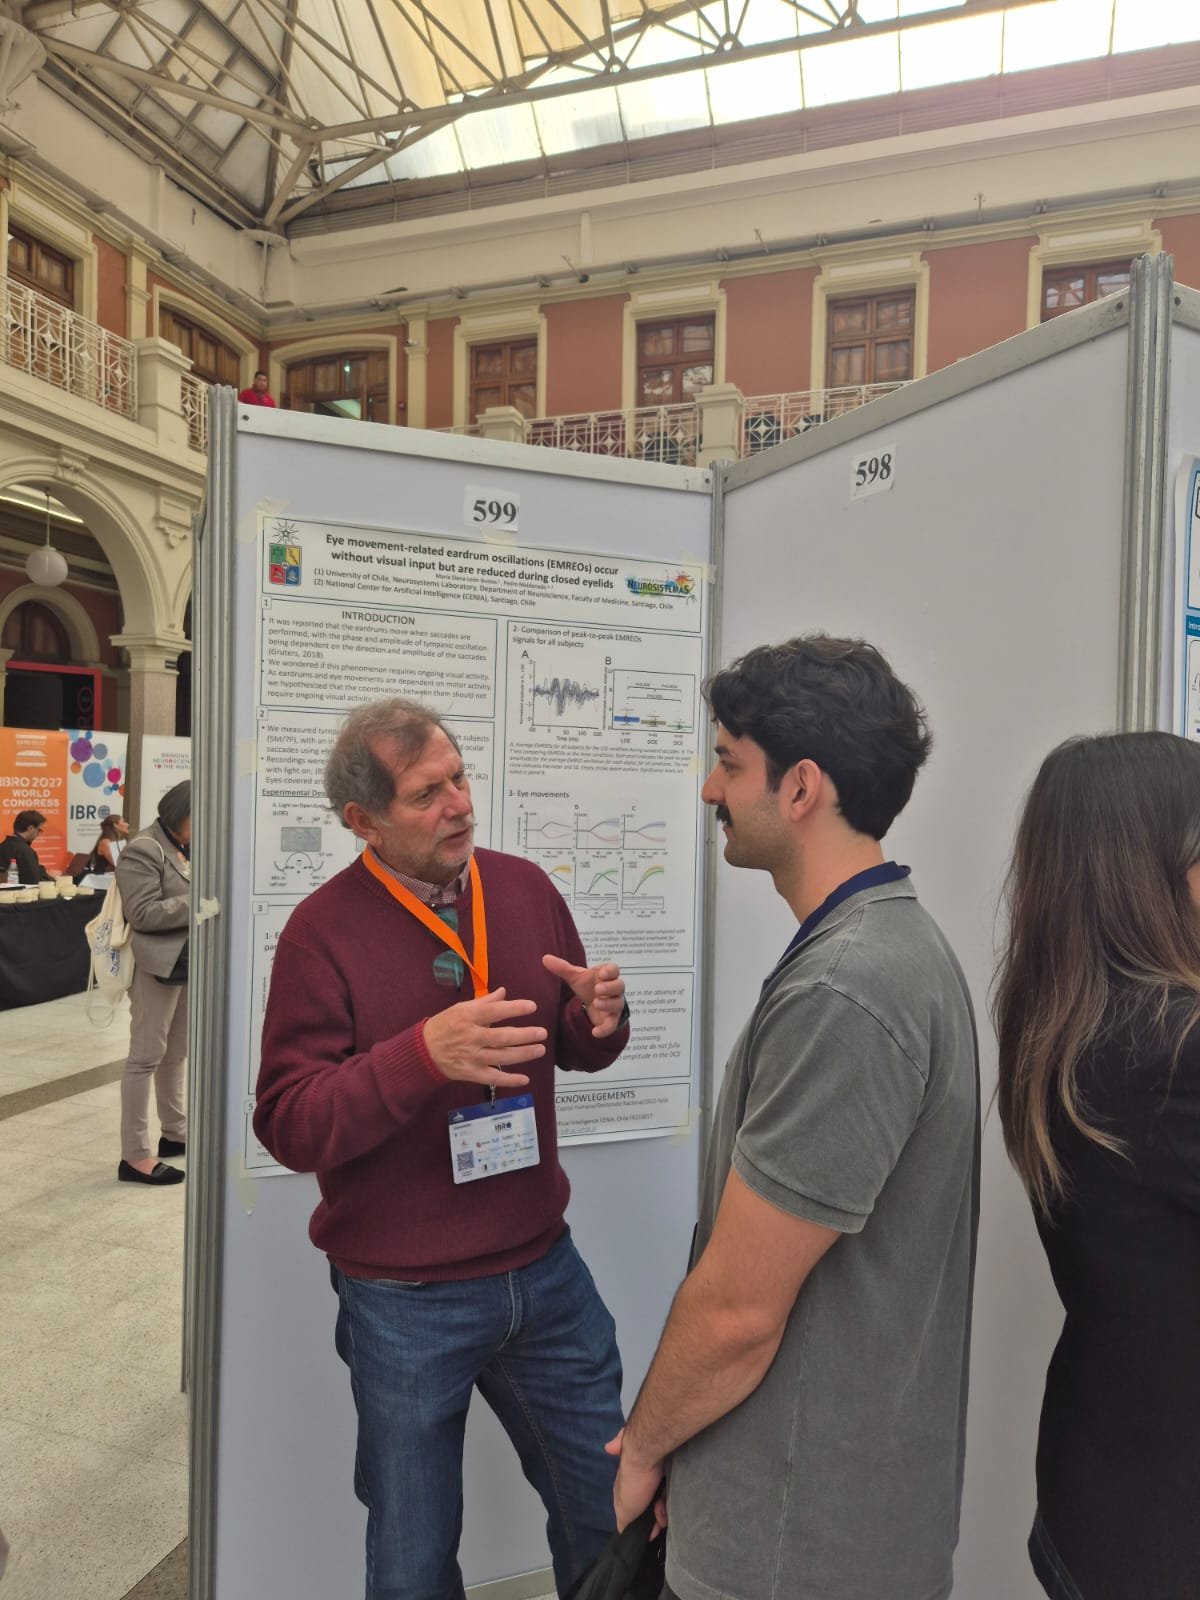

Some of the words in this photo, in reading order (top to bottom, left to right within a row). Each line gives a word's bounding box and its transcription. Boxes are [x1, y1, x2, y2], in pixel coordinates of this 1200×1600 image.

[856, 453, 892, 486] 598
[474, 500, 516, 524] 599
[326, 534, 344, 547] Eye
[348, 538, 444, 555] movement-related
[447, 549, 488, 561] eardrum
[492, 553, 544, 566] oscillations
[547, 558, 592, 574] (EMREOs)
[594, 565, 619, 574] occur
[332, 551, 373, 564] without
[376, 555, 406, 567] visual
[410, 558, 435, 571] input
[438, 561, 455, 572] but
[458, 566, 474, 574] are
[477, 567, 516, 579] reduced
[518, 570, 548, 584] during
[551, 574, 580, 585] closed
[582, 578, 614, 589] eyelids
[314, 567, 324, 577] (1)
[326, 568, 362, 581] University
[393, 575, 440, 587] Neurosystems
[480, 584, 518, 595] Department
[572, 593, 592, 604] Faculty
[314, 578, 324, 588] (2)
[326, 579, 356, 589] National
[358, 583, 380, 591] Center
[394, 586, 422, 595] Artificial
[424, 588, 462, 599] Intelligence
[520, 597, 536, 605] Chile
[627, 578, 690, 594] NEUROSISTEMAS
[264, 599, 269, 607] 1
[342, 610, 416, 625] INTRODUCTION
[292, 620, 324, 628] reported
[326, 622, 340, 630] that
[356, 626, 388, 634] eardrums
[522, 626, 562, 636] Comparison
[572, 630, 614, 641] peak-to-peak
[616, 633, 642, 642] EMREOs
[268, 629, 310, 640] performed,
[342, 634, 362, 642] phase
[380, 638, 414, 646] amplitude
[513, 636, 536, 646] signals
[558, 640, 584, 649] subjects
[268, 638, 288, 648] being
[290, 640, 328, 649] dependent
[402, 649, 434, 658] amplitude
[521, 650, 529, 658] A
[605, 656, 612, 665] B
[282, 660, 318, 669] wondered
[341, 664, 386, 674] phenomenon
[418, 671, 444, 680] ongoing
[278, 670, 312, 679] eardrums
[398, 678, 434, 687] dependent
[280, 680, 328, 690] hypothesized
[403, 688, 432, 696] between
[268, 691, 294, 699] require
[296, 692, 324, 702] ongoing
[464, 735, 489, 743] subjects
[266, 756, 306, 764] Recordings
[12, 790, 50, 798] WORLD
[262, 789, 310, 798] Experimental
[517, 790, 530, 798] Eye
[2, 799, 60, 808] CONGRESS
[556, 1090, 636, 1104] CKNOWLEGEMENTS
